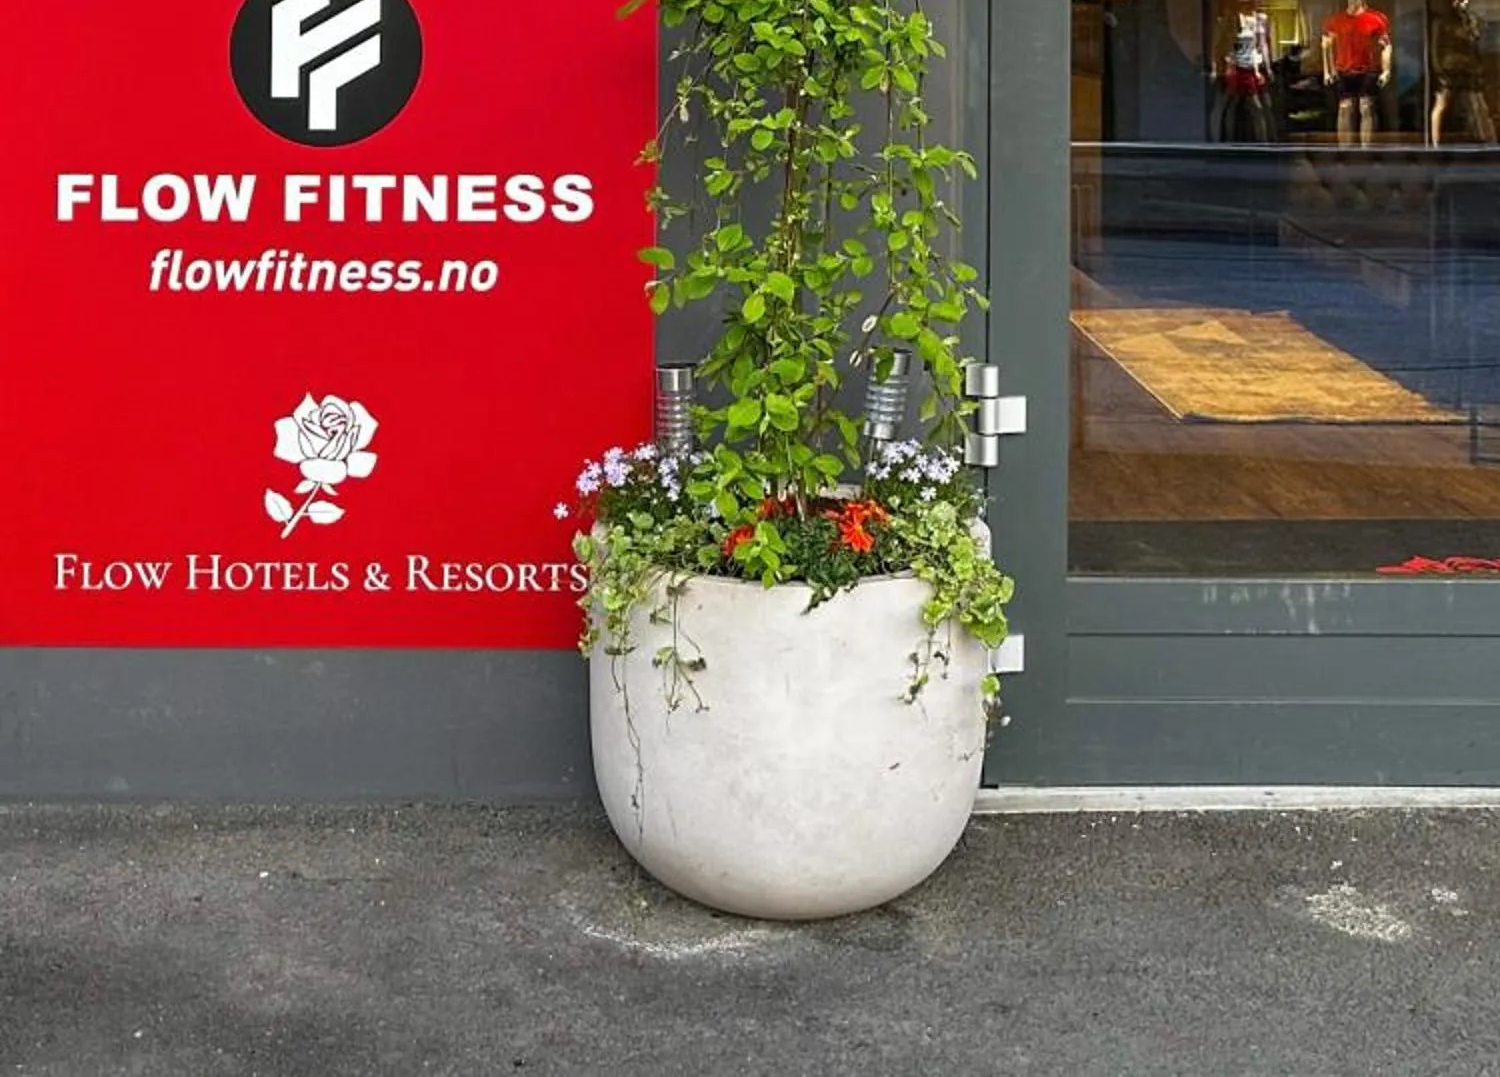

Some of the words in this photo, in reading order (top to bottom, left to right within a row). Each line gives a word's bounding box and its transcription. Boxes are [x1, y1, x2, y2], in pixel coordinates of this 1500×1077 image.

[57, 173, 256, 222] FLOW
[284, 173, 594, 222] FITNESS
[149, 249, 498, 292] flowfitness.no
[363, 562, 390, 591] &
